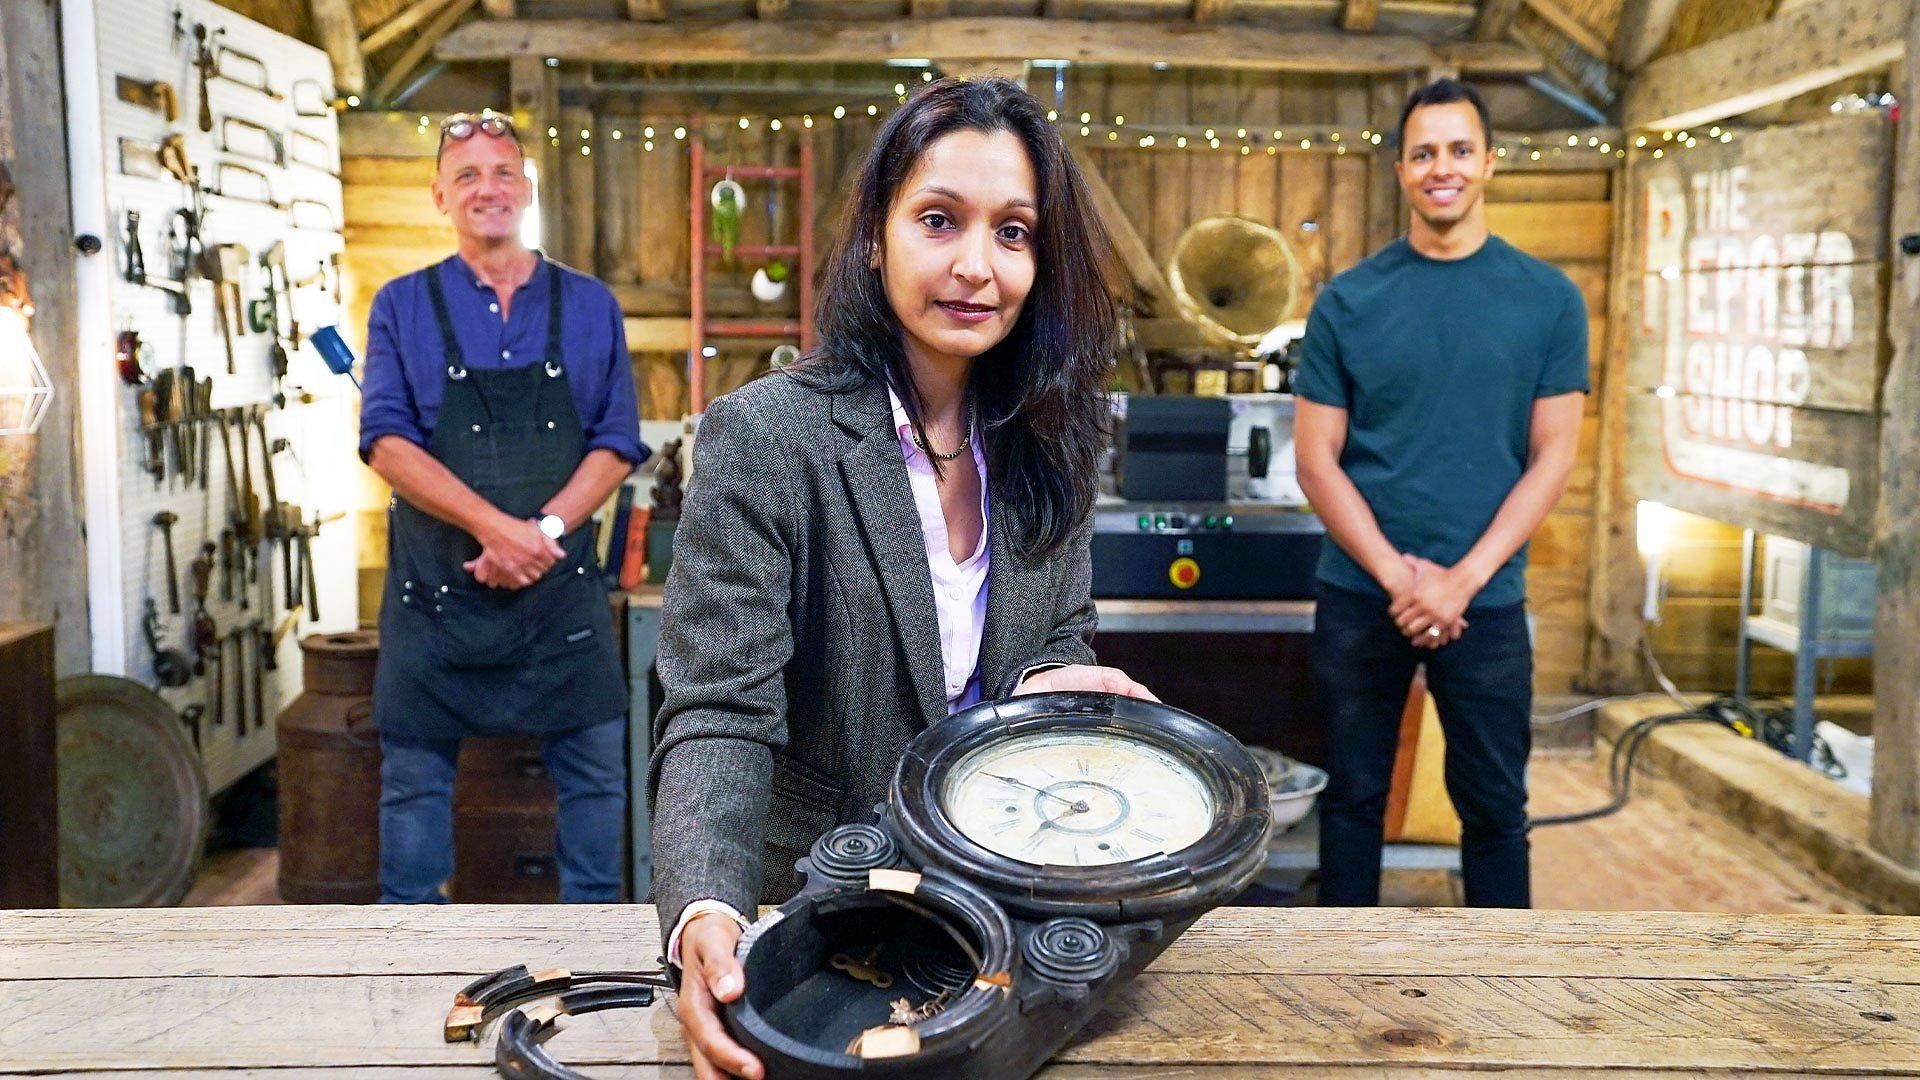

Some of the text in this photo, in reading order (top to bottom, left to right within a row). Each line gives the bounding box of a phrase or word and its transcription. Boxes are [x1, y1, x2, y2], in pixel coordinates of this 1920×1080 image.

[1691, 165, 1751, 231] THE
[1641, 176, 1855, 348] REPAIR
[1683, 342, 1811, 449] SHOP
